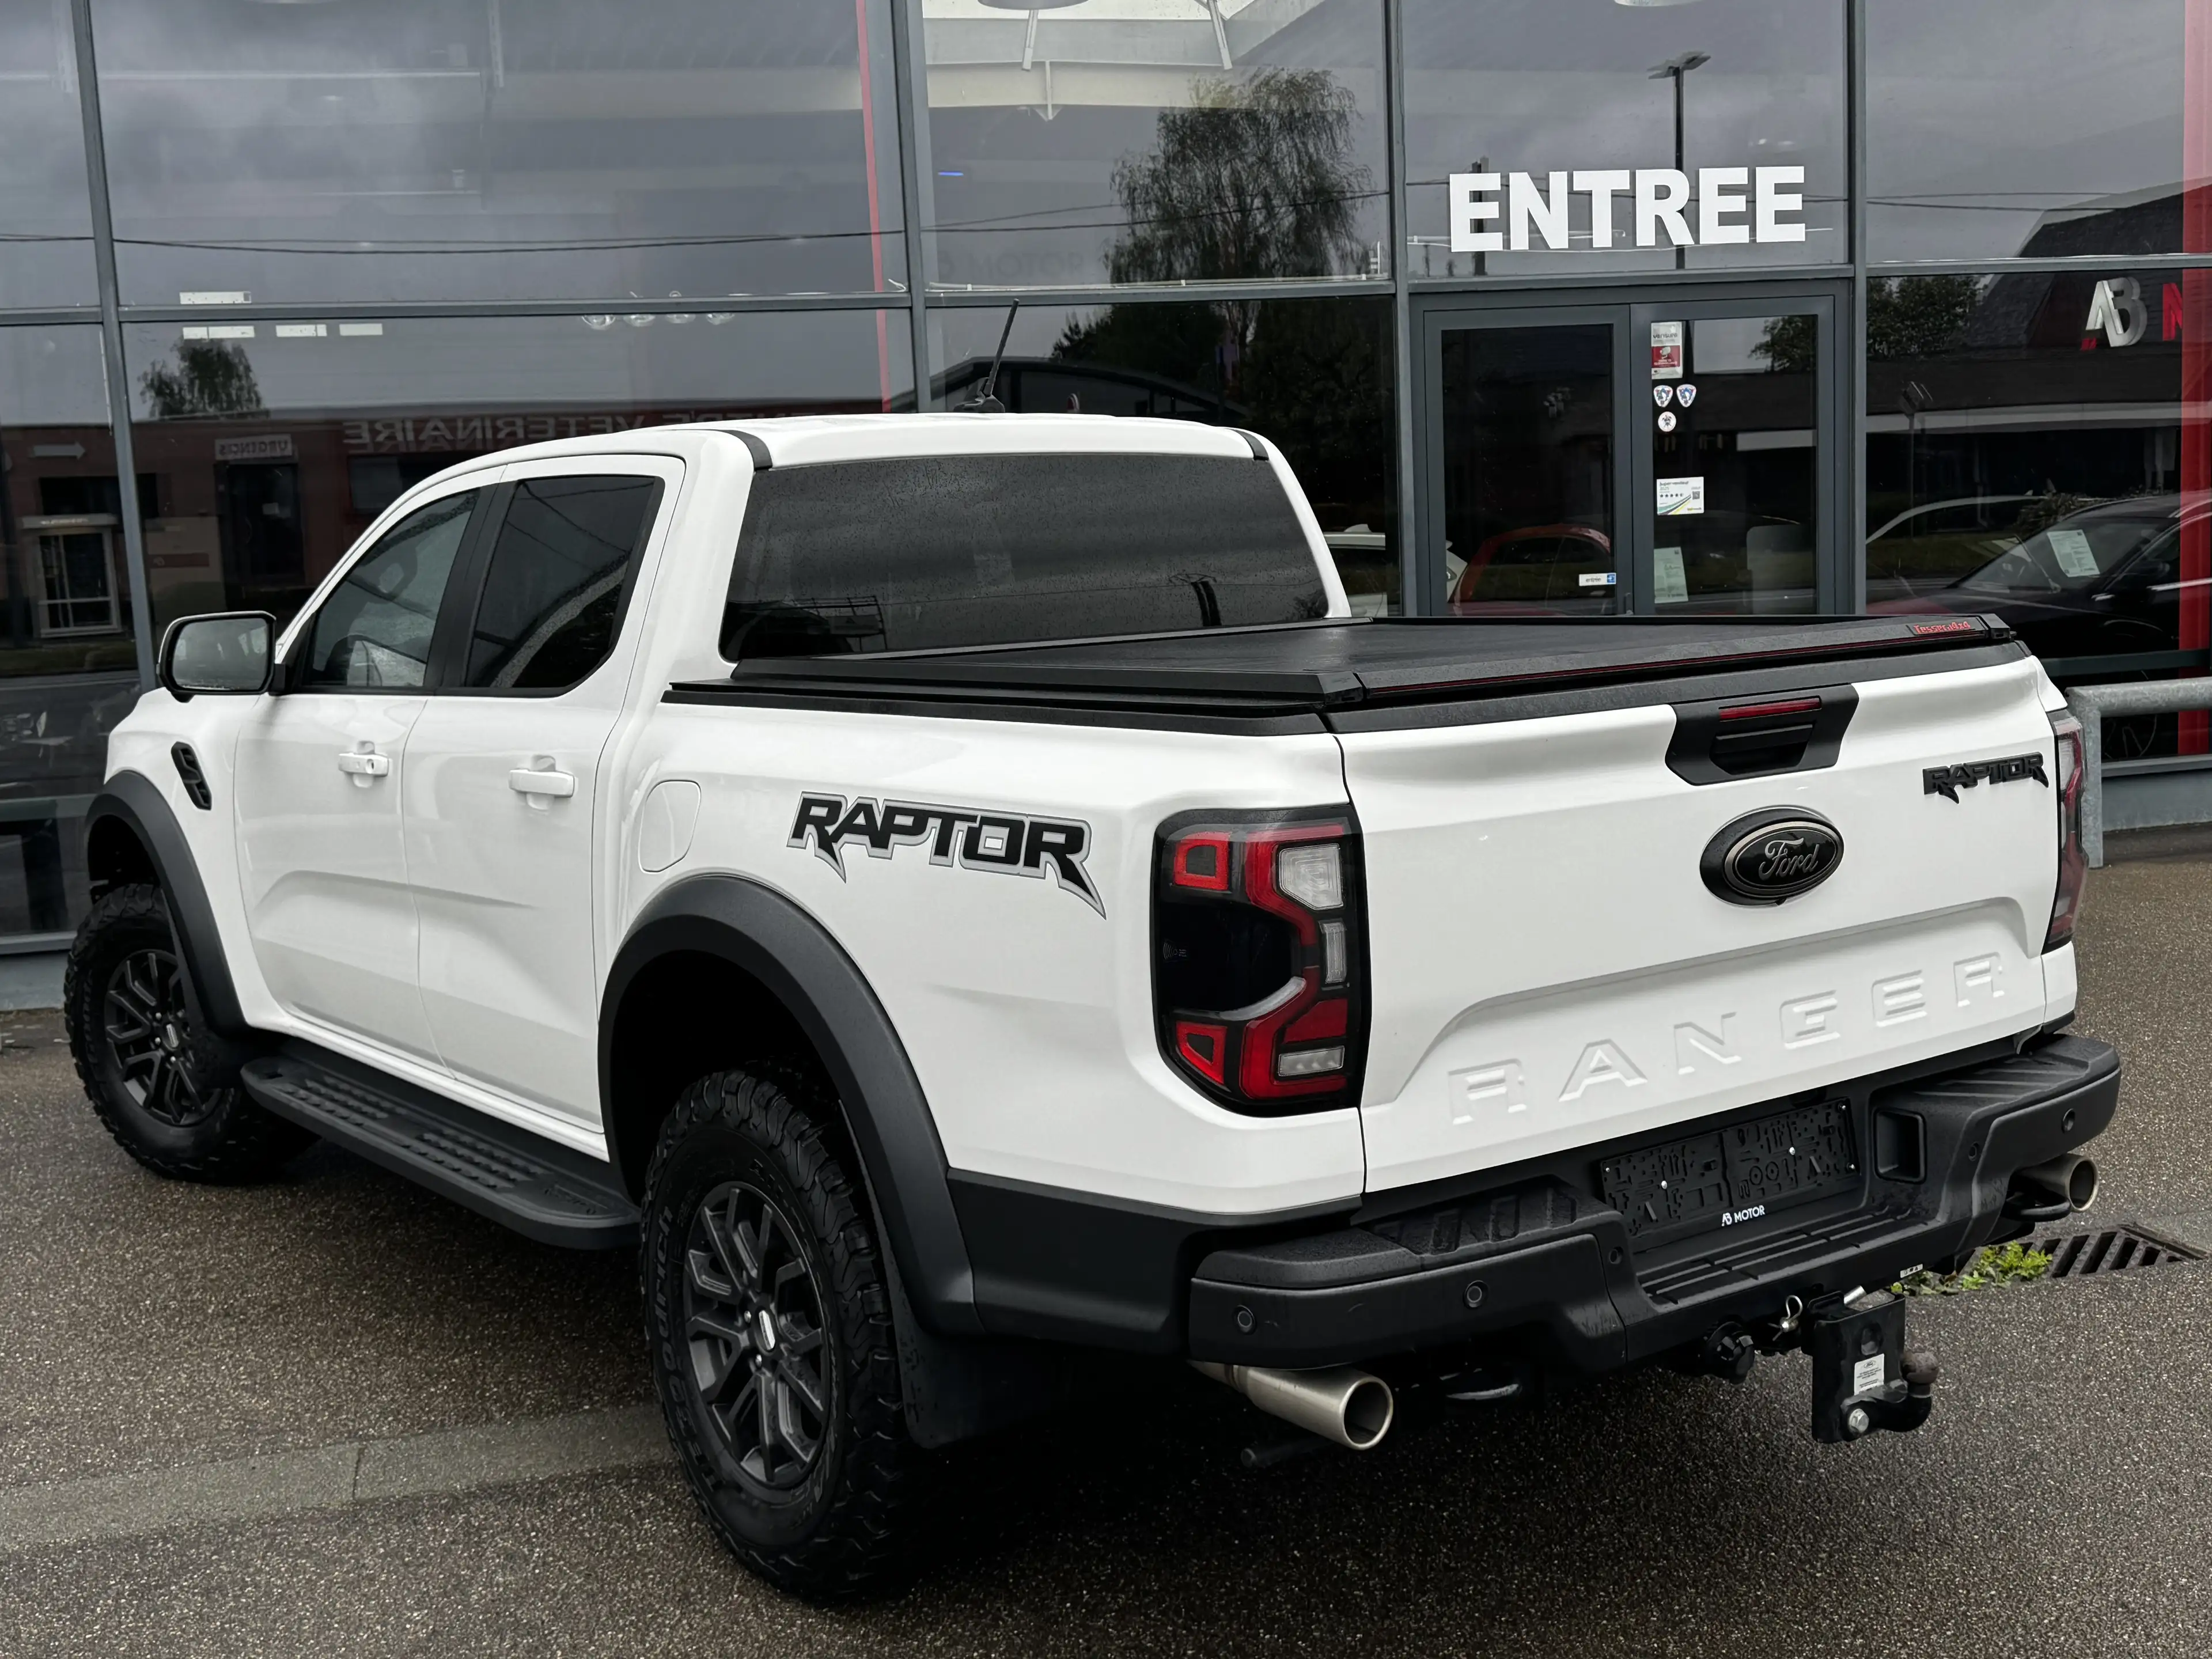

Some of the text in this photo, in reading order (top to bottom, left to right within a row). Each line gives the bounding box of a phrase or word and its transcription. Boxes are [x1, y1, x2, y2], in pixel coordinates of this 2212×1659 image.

[1449, 166, 1805, 252] ENTREE
[1923, 751, 2049, 804] RAPTOR
[786, 791, 1107, 921] RAPTOR
[1759, 837, 1820, 881] Ford
[1447, 952, 2006, 1126] RANGER
[1734, 1205, 1766, 1223] MOTOR
